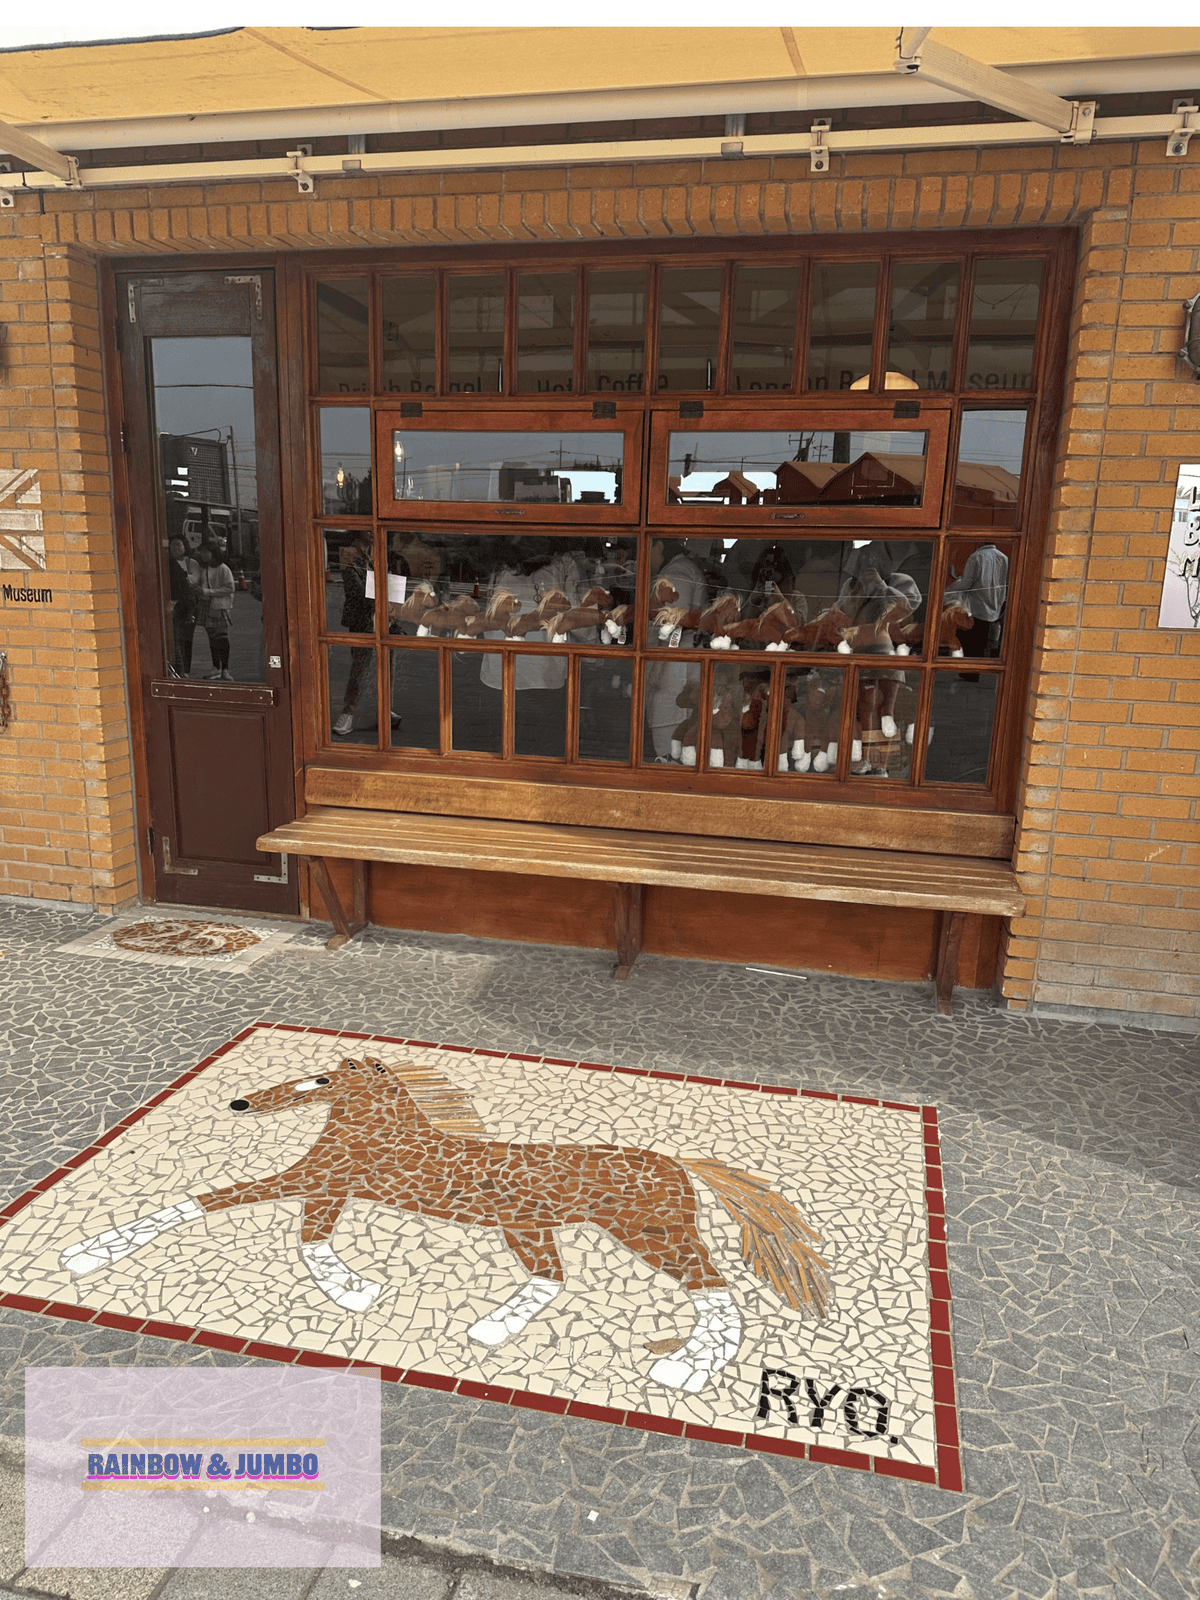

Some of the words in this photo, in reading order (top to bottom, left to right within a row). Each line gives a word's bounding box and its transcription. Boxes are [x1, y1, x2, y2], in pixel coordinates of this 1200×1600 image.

[598, 373, 669, 392] Coffe
[928, 369, 1032, 391] Mseum
[2, 584, 53, 603] Museum
